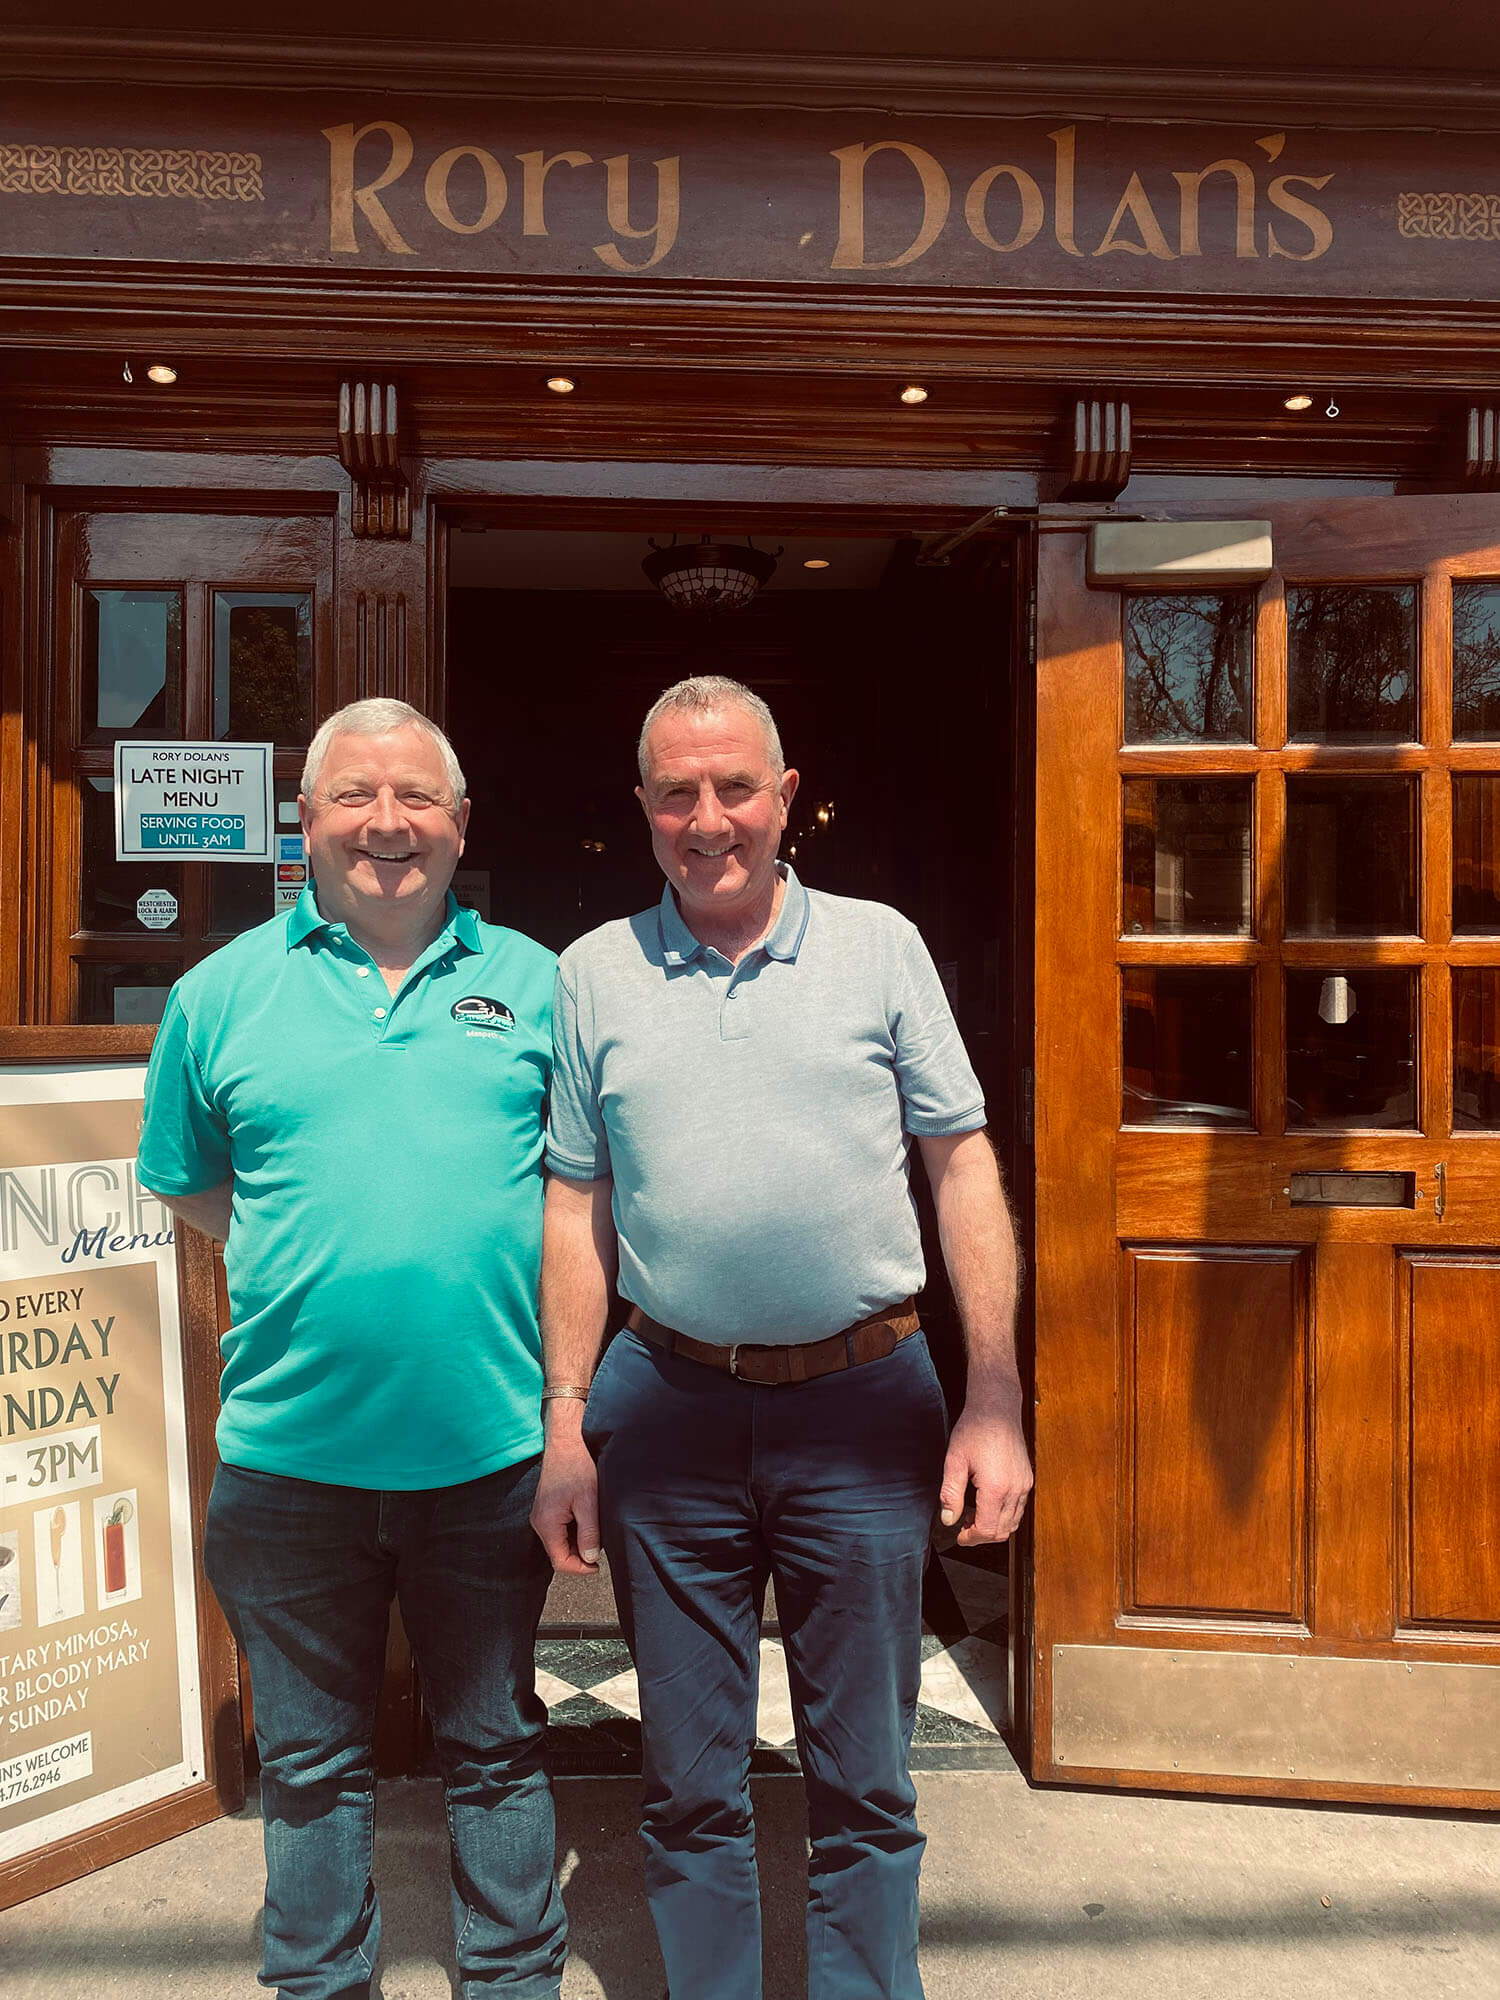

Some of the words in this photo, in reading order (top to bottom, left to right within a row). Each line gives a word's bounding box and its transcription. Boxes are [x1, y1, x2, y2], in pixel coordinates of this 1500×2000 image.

[320, 120, 680, 272] Rory
[829, 124, 1335, 270] Dolan's
[152, 752, 181, 761] RORY
[184, 752, 230, 762] DOLAN'S
[131, 768, 176, 784] LATE
[182, 769, 244, 785] NIGHT
[163, 791, 218, 807] MENU
[141, 816, 197, 829] SERVING
[201, 817, 245, 830] FOOD
[158, 833, 199, 845] UNTIL
[202, 834, 231, 848] 3AM
[61, 1226, 175, 1263] Menu
[16, 1287, 84, 1320] EVERY
[0, 1373, 120, 1437] NDAY
[27, 1435, 99, 1487] 3PM
[0, 1642, 51, 1678] TARY
[55, 1618, 138, 1661] MIMOSA,
[15, 1657, 92, 1703] BLOODY
[96, 1639, 150, 1676] MARY
[9, 1687, 89, 1733] SUNDAY
[25, 1738, 89, 1772] WELCOME
